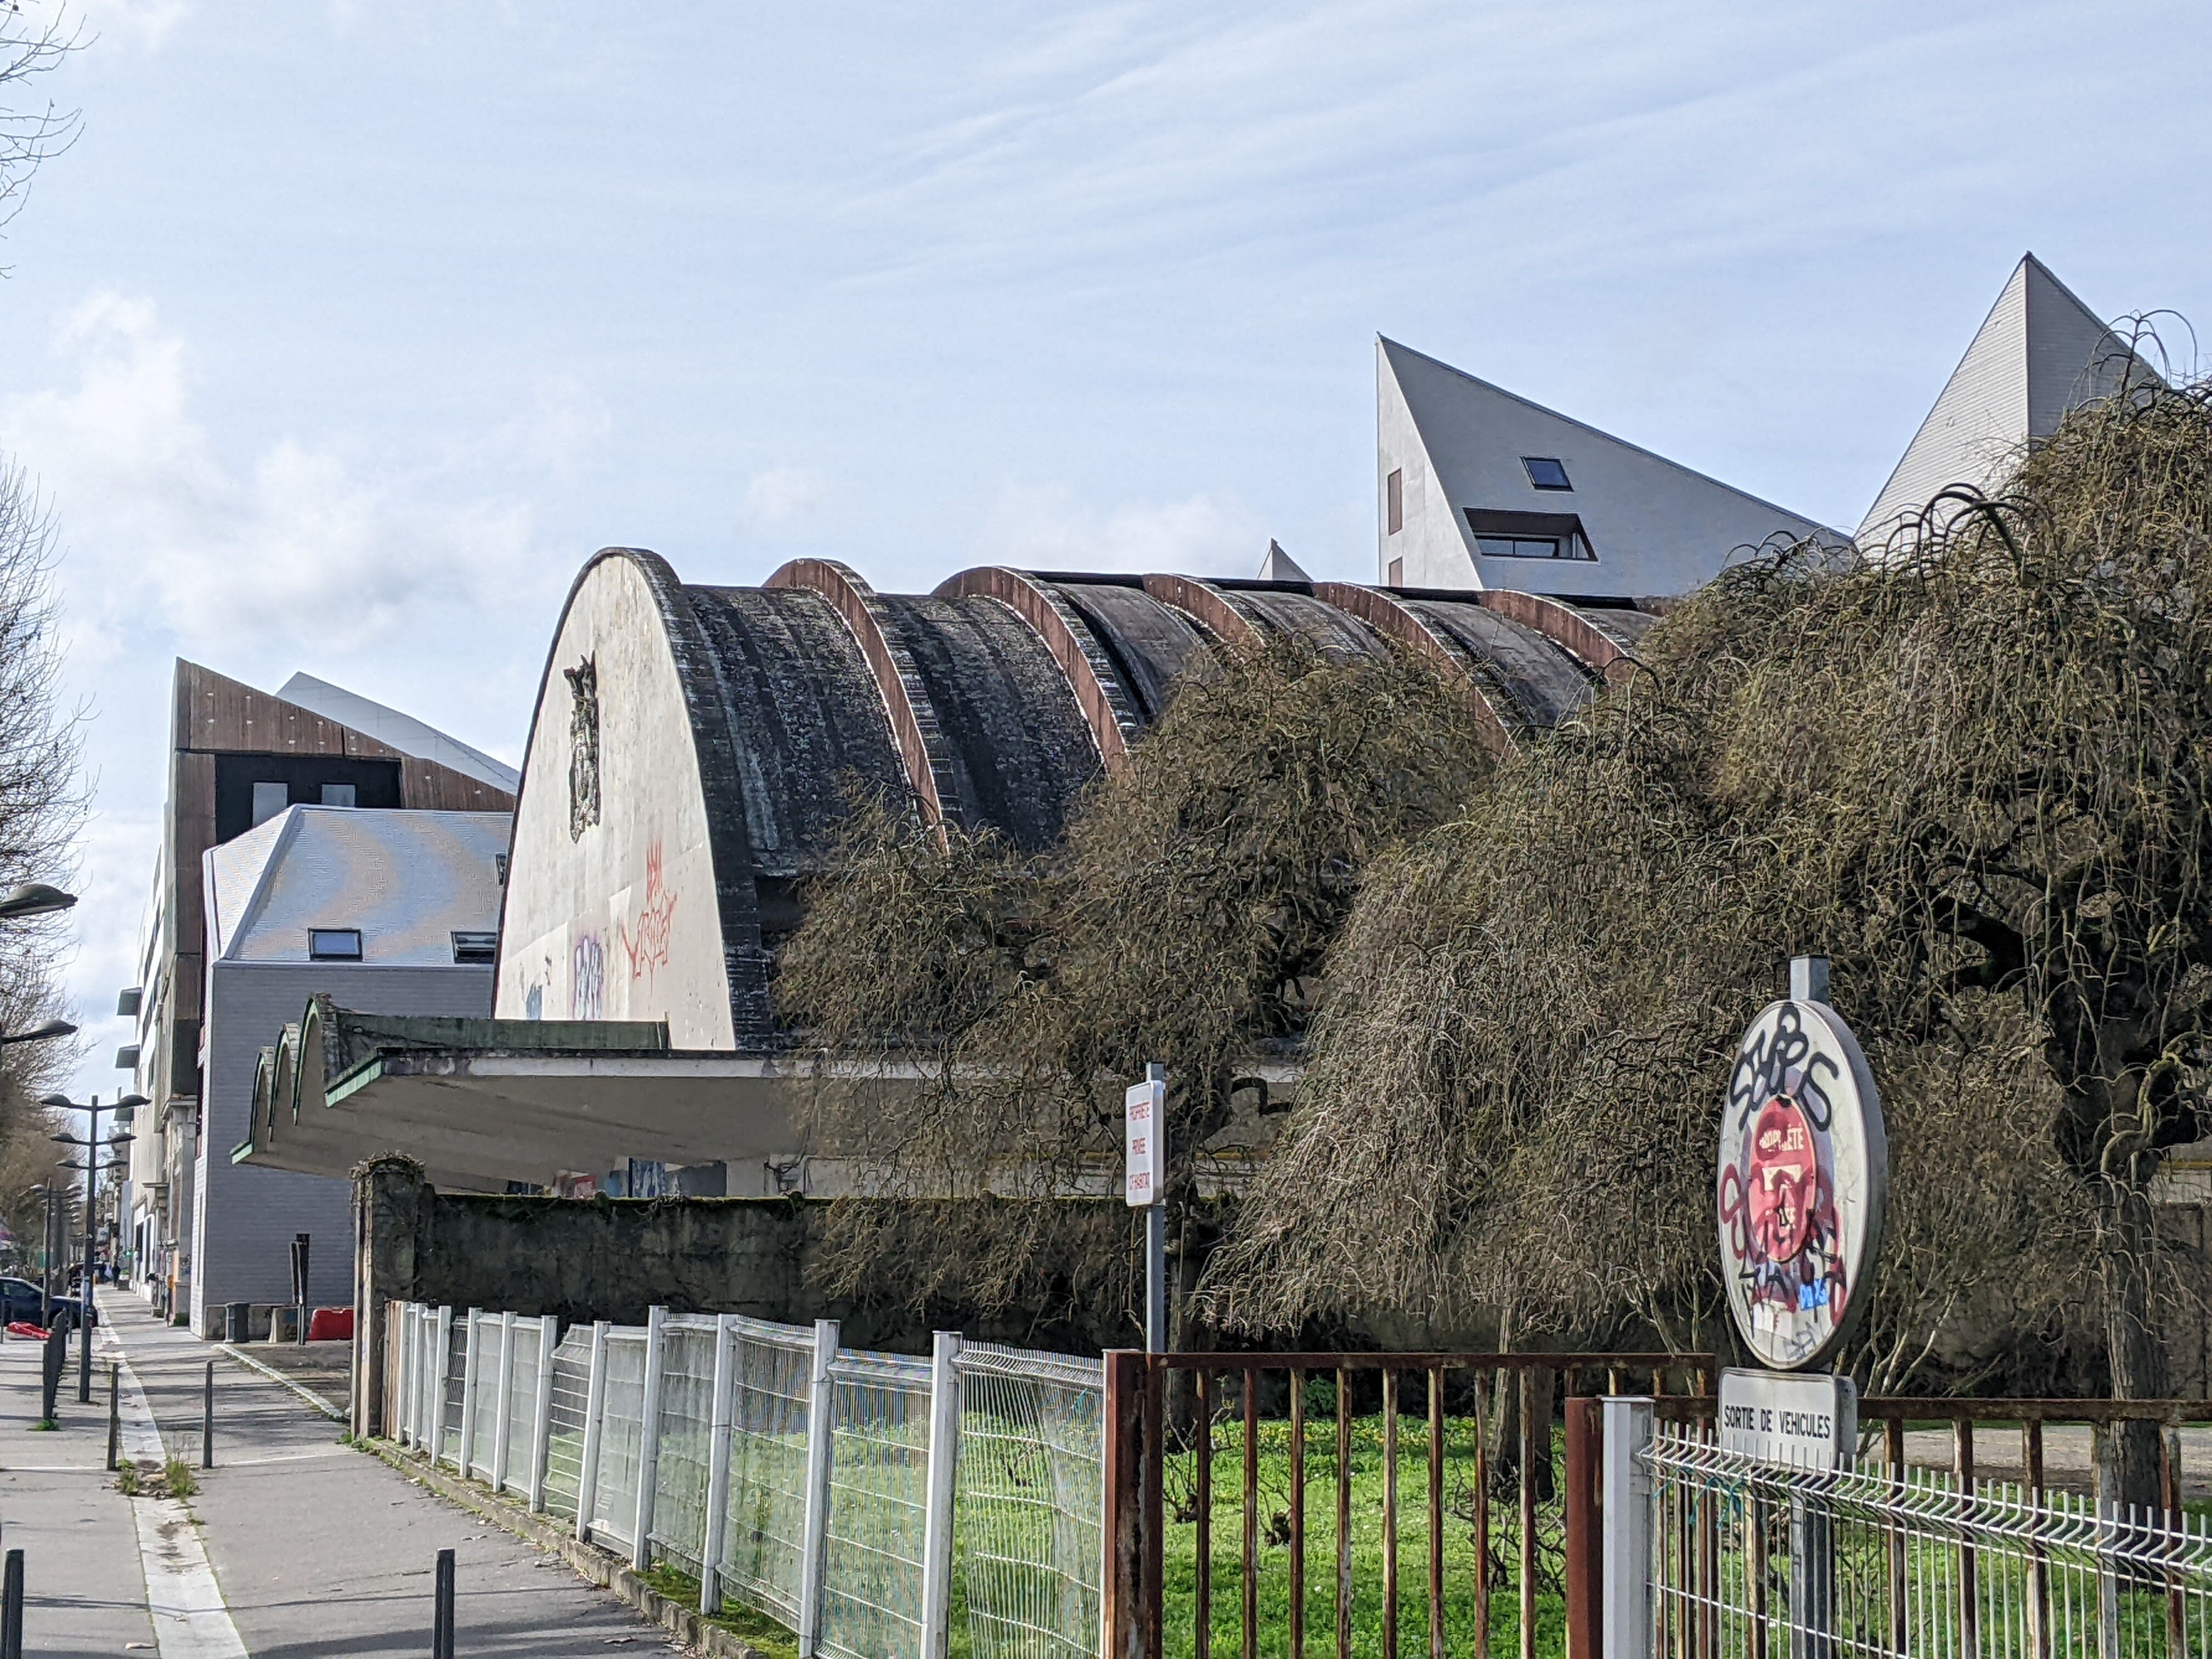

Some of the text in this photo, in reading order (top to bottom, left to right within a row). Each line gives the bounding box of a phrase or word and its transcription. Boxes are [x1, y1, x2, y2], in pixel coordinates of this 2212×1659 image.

[1724, 1405, 1831, 1439] SORTIE DE VEHICULES
